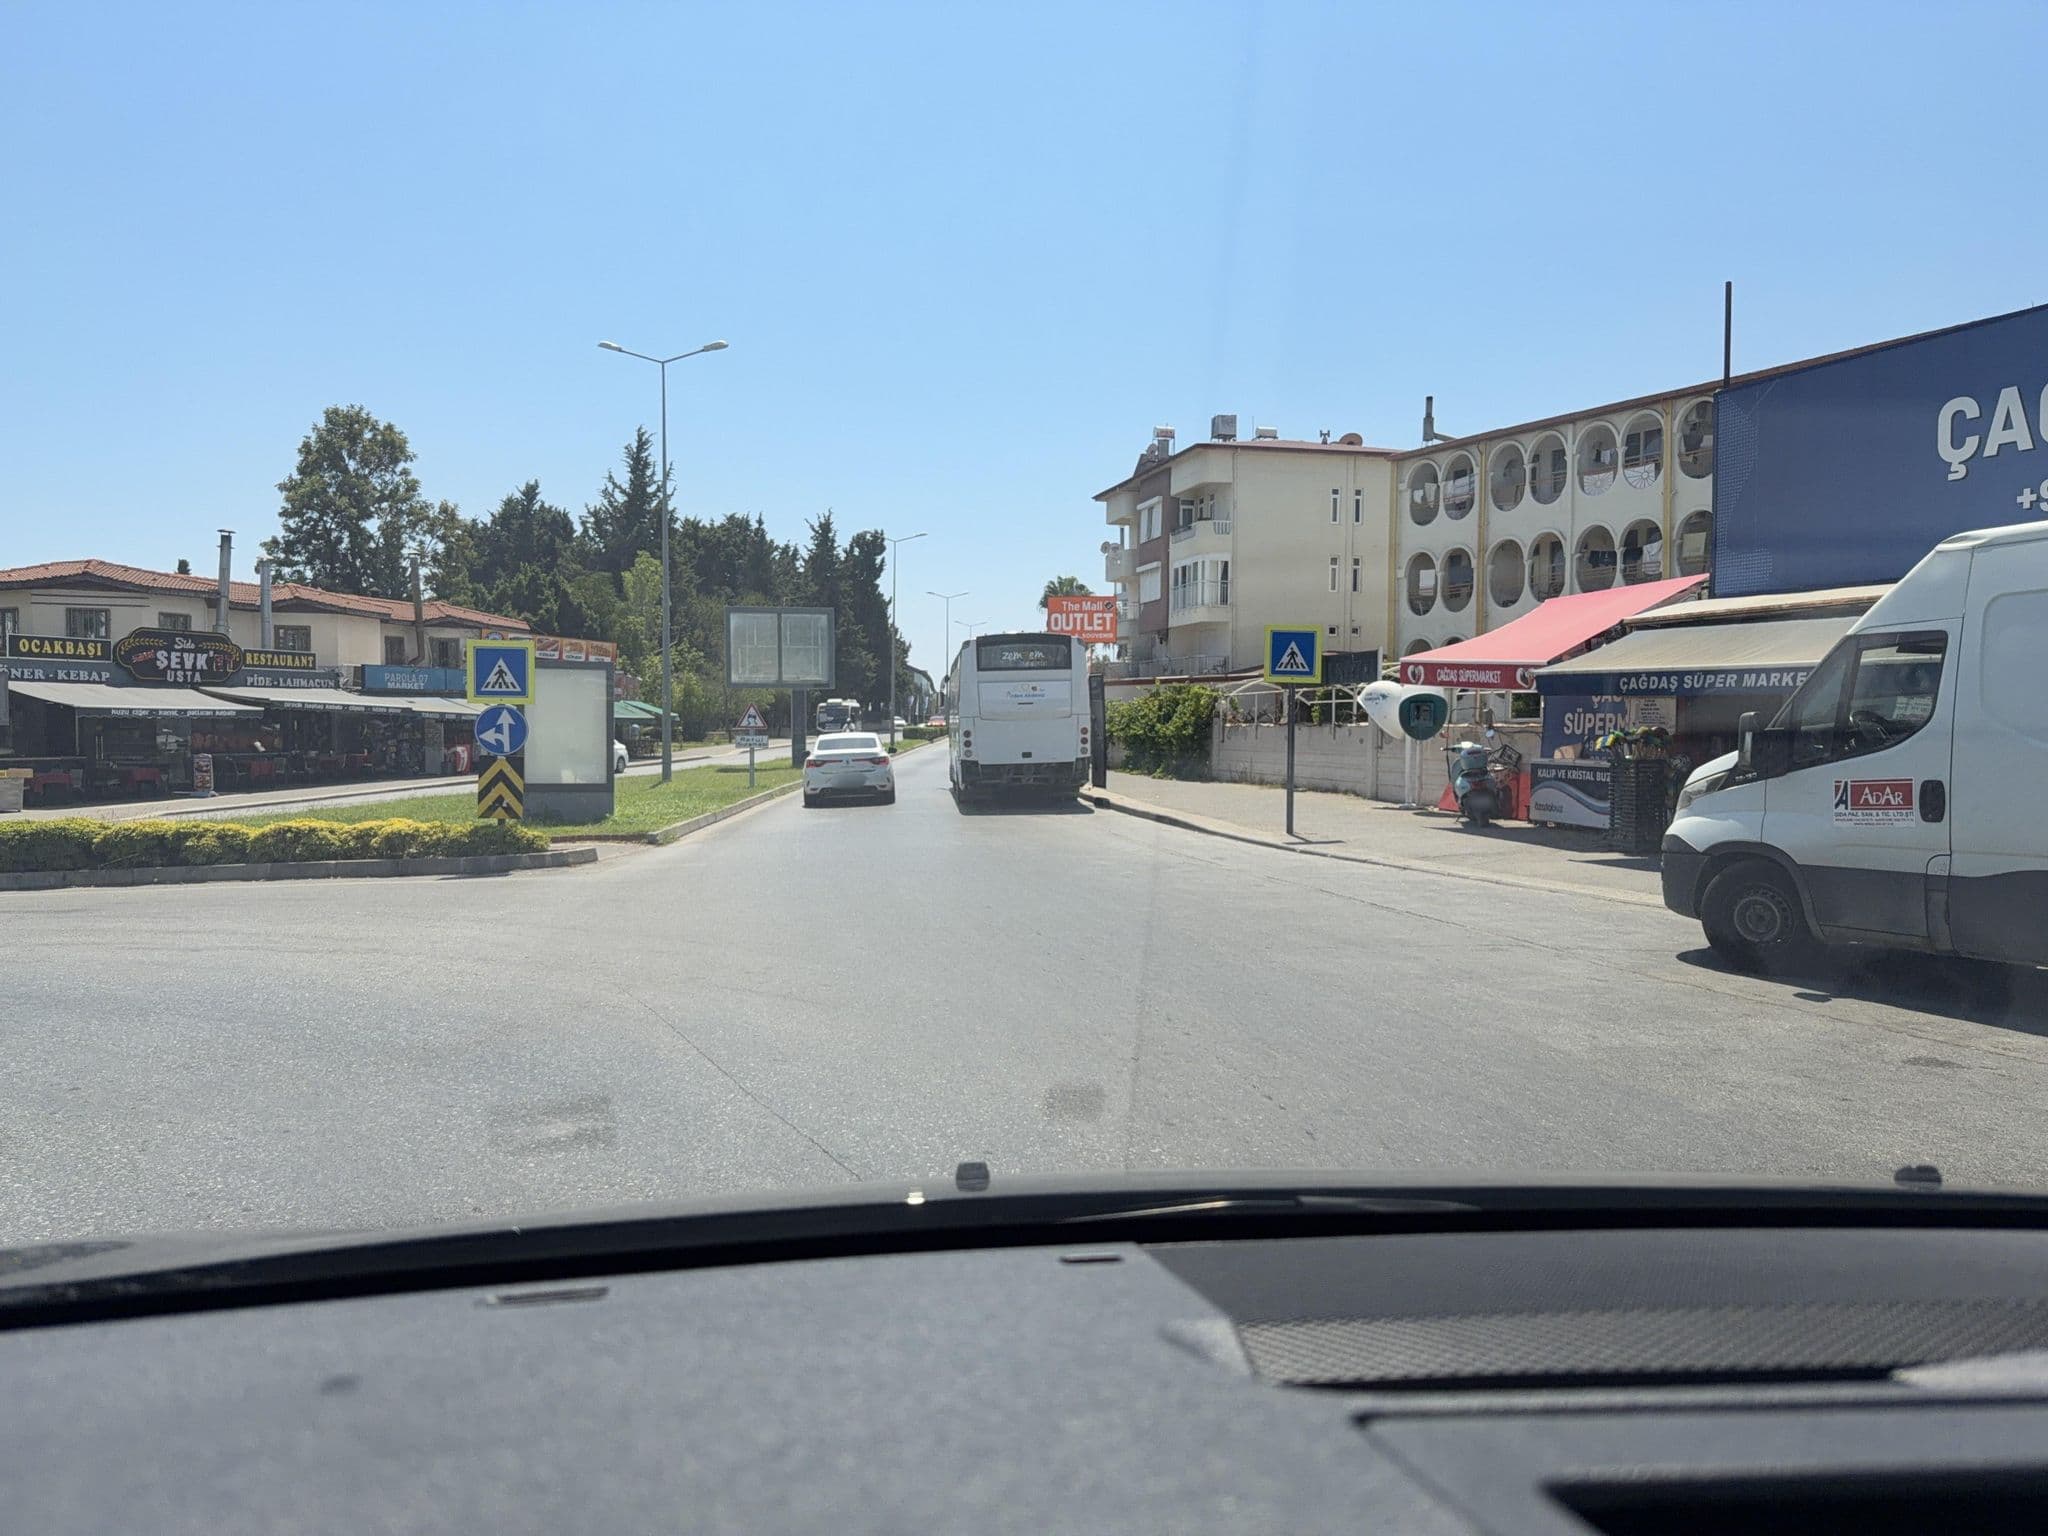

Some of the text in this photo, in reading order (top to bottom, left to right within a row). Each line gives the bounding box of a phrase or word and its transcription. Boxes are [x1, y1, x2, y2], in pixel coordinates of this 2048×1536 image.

[1937, 382, 2048, 481] ÇA
[1062, 601, 1103, 611] The Mall
[1050, 613, 1114, 631] OUTLET
[19, 638, 103, 658] OCAKBAŞI
[246, 652, 314, 667] RESTAURANT
[57, 669, 111, 682] KEBAP
[166, 669, 202, 683] USTA
[246, 674, 272, 686] PİDE
[279, 676, 335, 688] LAHMACUN
[384, 672, 418, 683] PAROLA
[1459, 667, 1502, 684] SÜPERMARKET
[1619, 674, 1678, 693] ÇAĞDAŞ
[1683, 672, 1737, 689] SÜPER
[387, 682, 425, 690] MARKET
[1537, 768, 1556, 778] KALIP
[1557, 769, 1567, 779] VE
[1567, 768, 1594, 781] KRİSTAL
